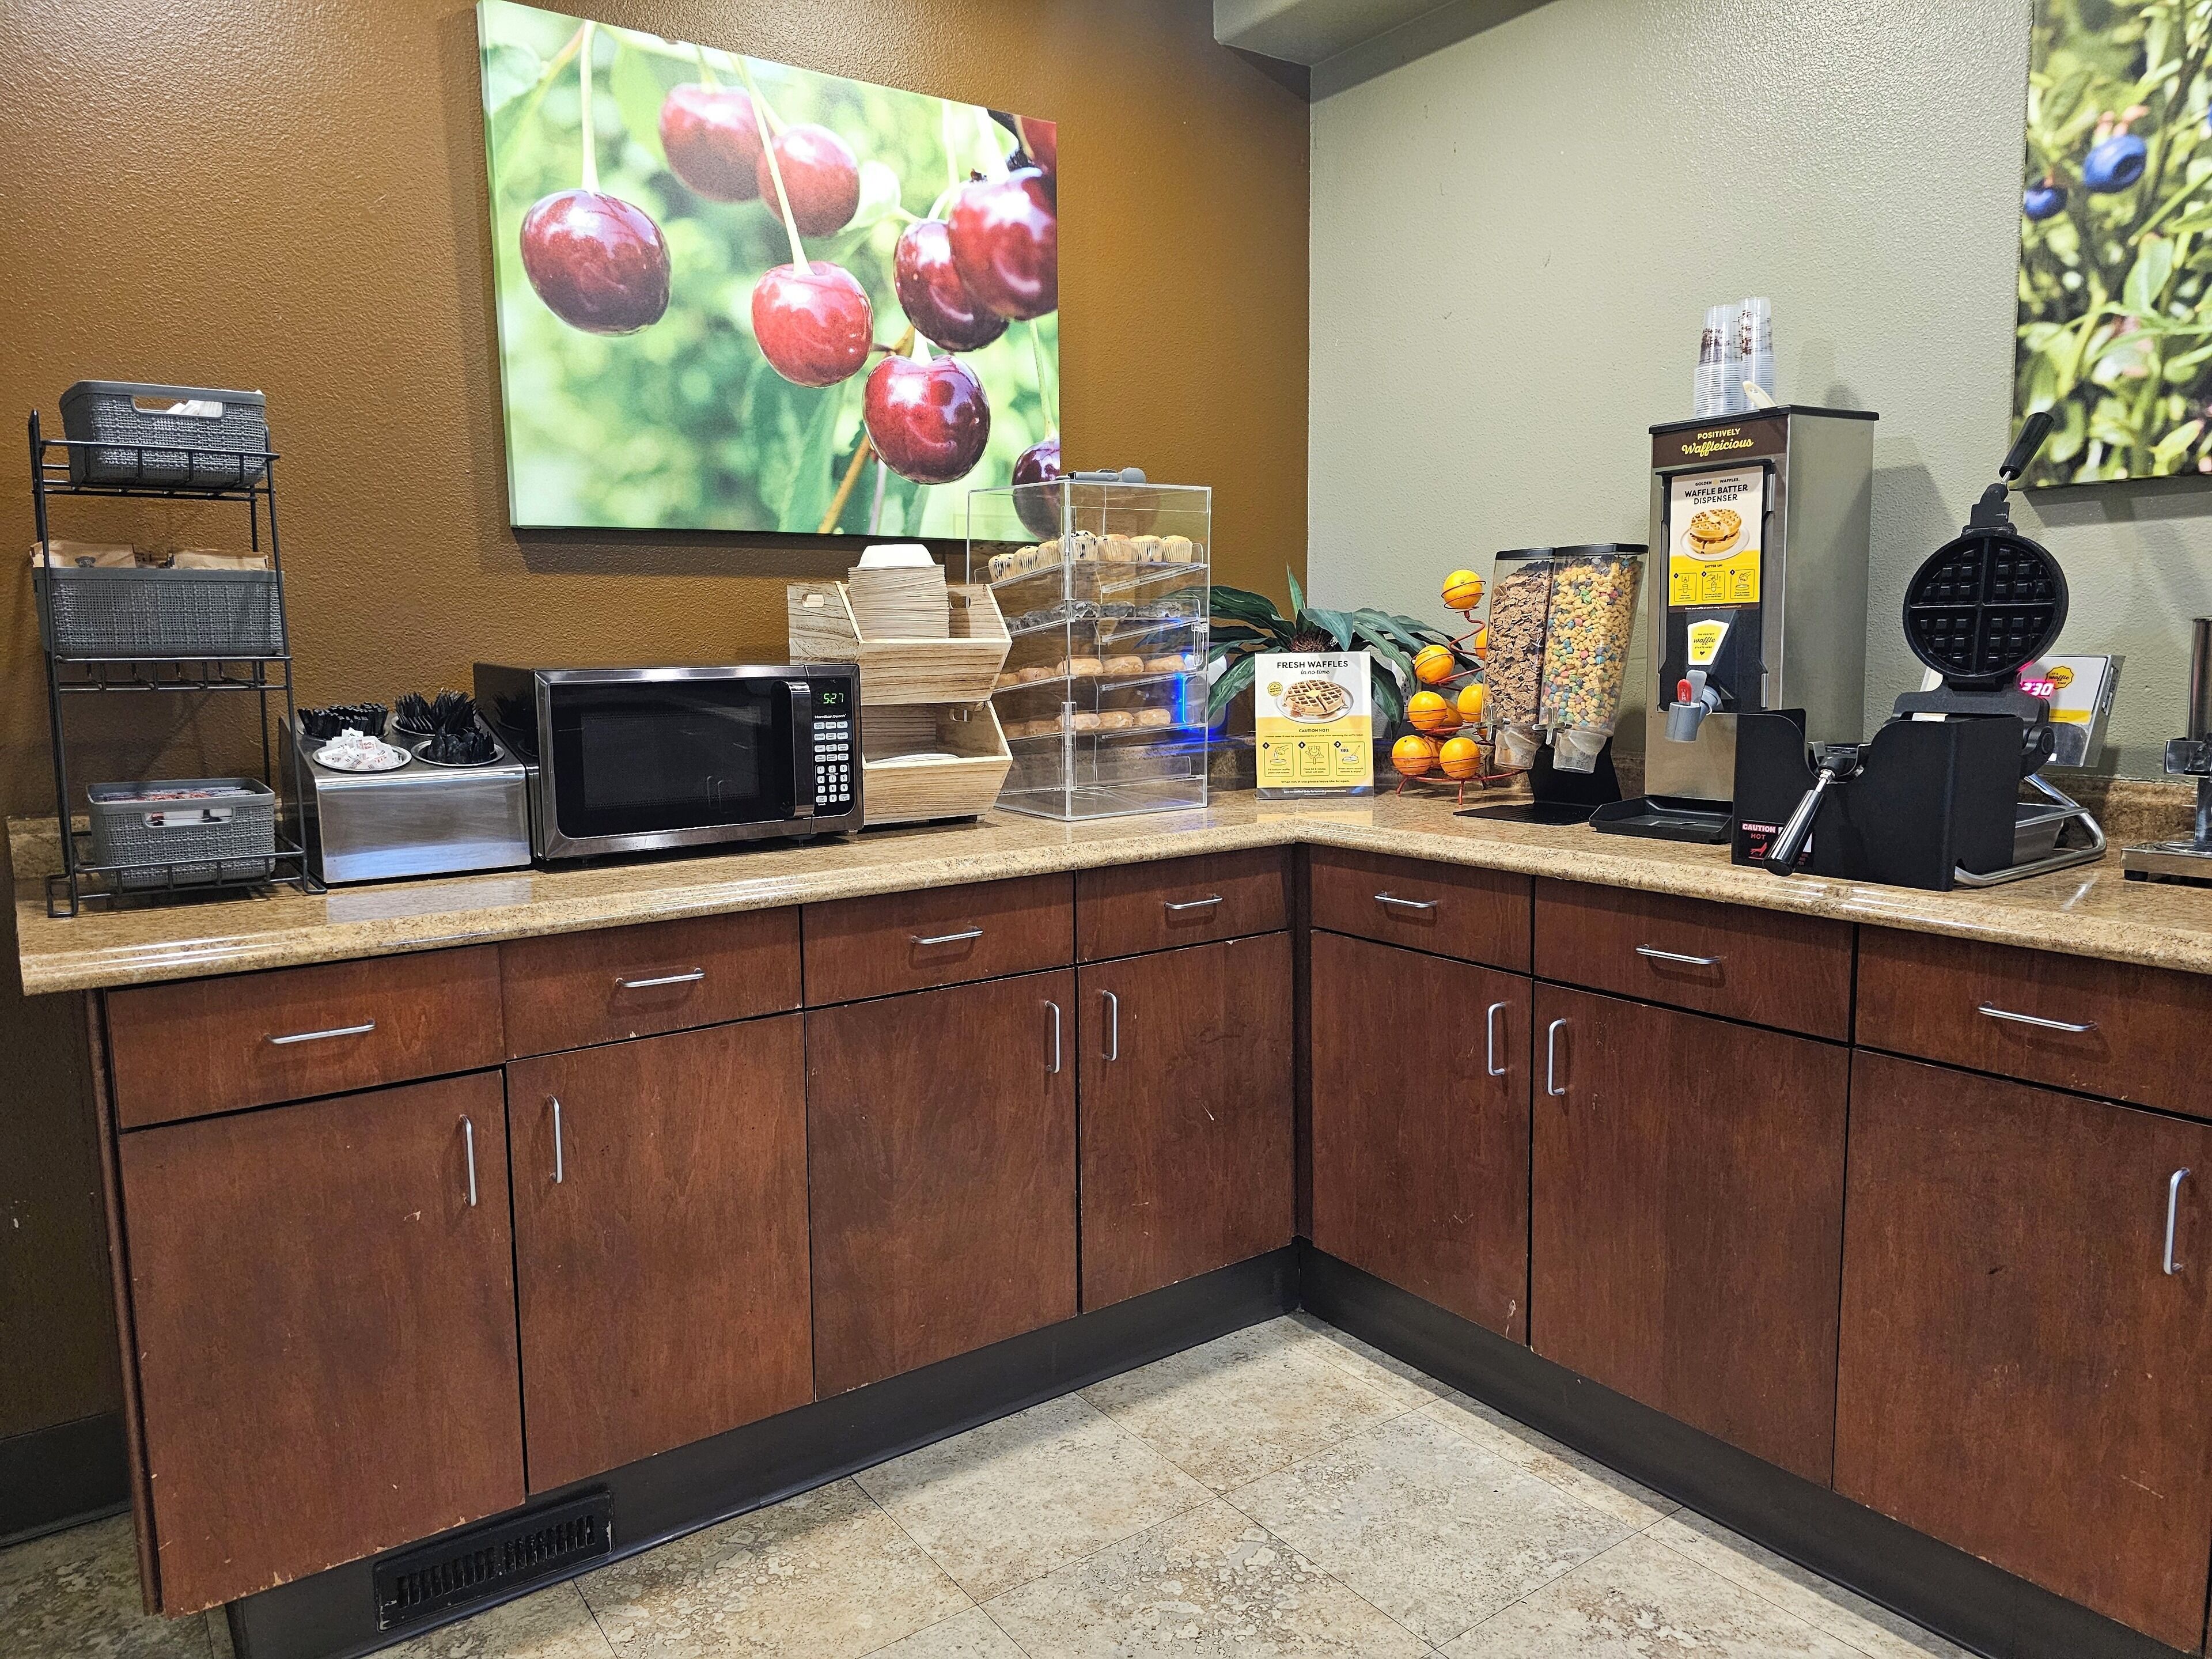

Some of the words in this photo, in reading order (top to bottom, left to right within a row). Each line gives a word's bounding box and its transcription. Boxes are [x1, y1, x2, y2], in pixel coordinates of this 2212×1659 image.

[1697, 427, 1741, 440] POSITIVELY
[1681, 438, 1754, 457] Waffleicious
[1685, 488, 1715, 498] WAFFLE
[1718, 484, 1748, 494] BATTER
[1694, 494, 1738, 505] DISPENSER
[1694, 637, 1715, 645] waffle
[1742, 823, 1776, 834] CAUTION
